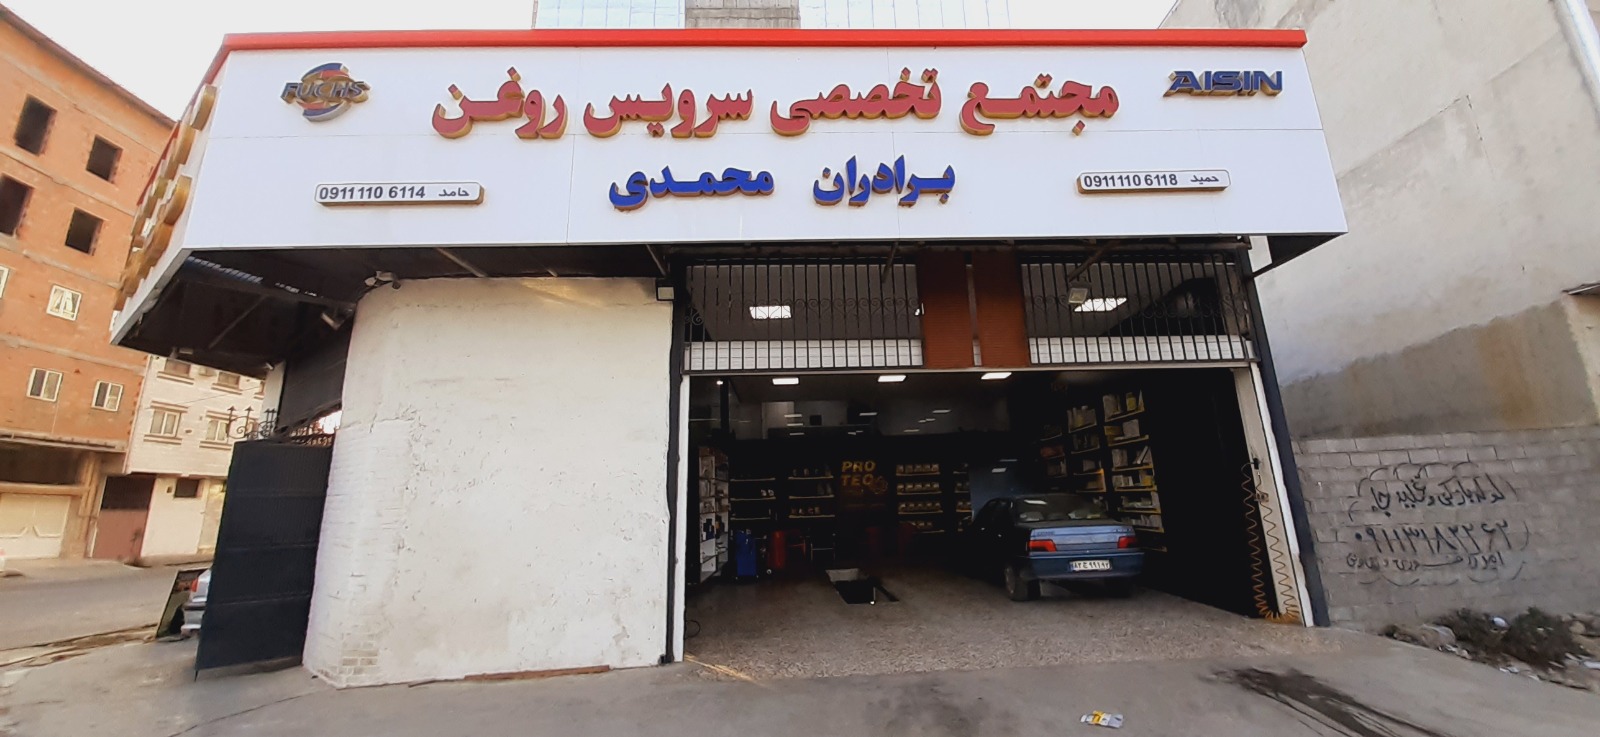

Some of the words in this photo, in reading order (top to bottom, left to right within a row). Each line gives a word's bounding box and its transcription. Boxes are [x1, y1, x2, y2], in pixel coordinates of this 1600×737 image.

[281, 79, 369, 106] FUCHS
[432, 67, 567, 138] روغن
[770, 67, 942, 135] تخصصی
[959, 74, 1120, 135] مجتمع
[1162, 70, 1284, 97] AISIN
[583, 82, 754, 138] سرویس
[438, 187, 470, 197] حامد
[608, 165, 774, 211] محمدی
[812, 155, 956, 206] برادران
[1190, 174, 1220, 185] حمید
[842, 461, 876, 473] PRO
